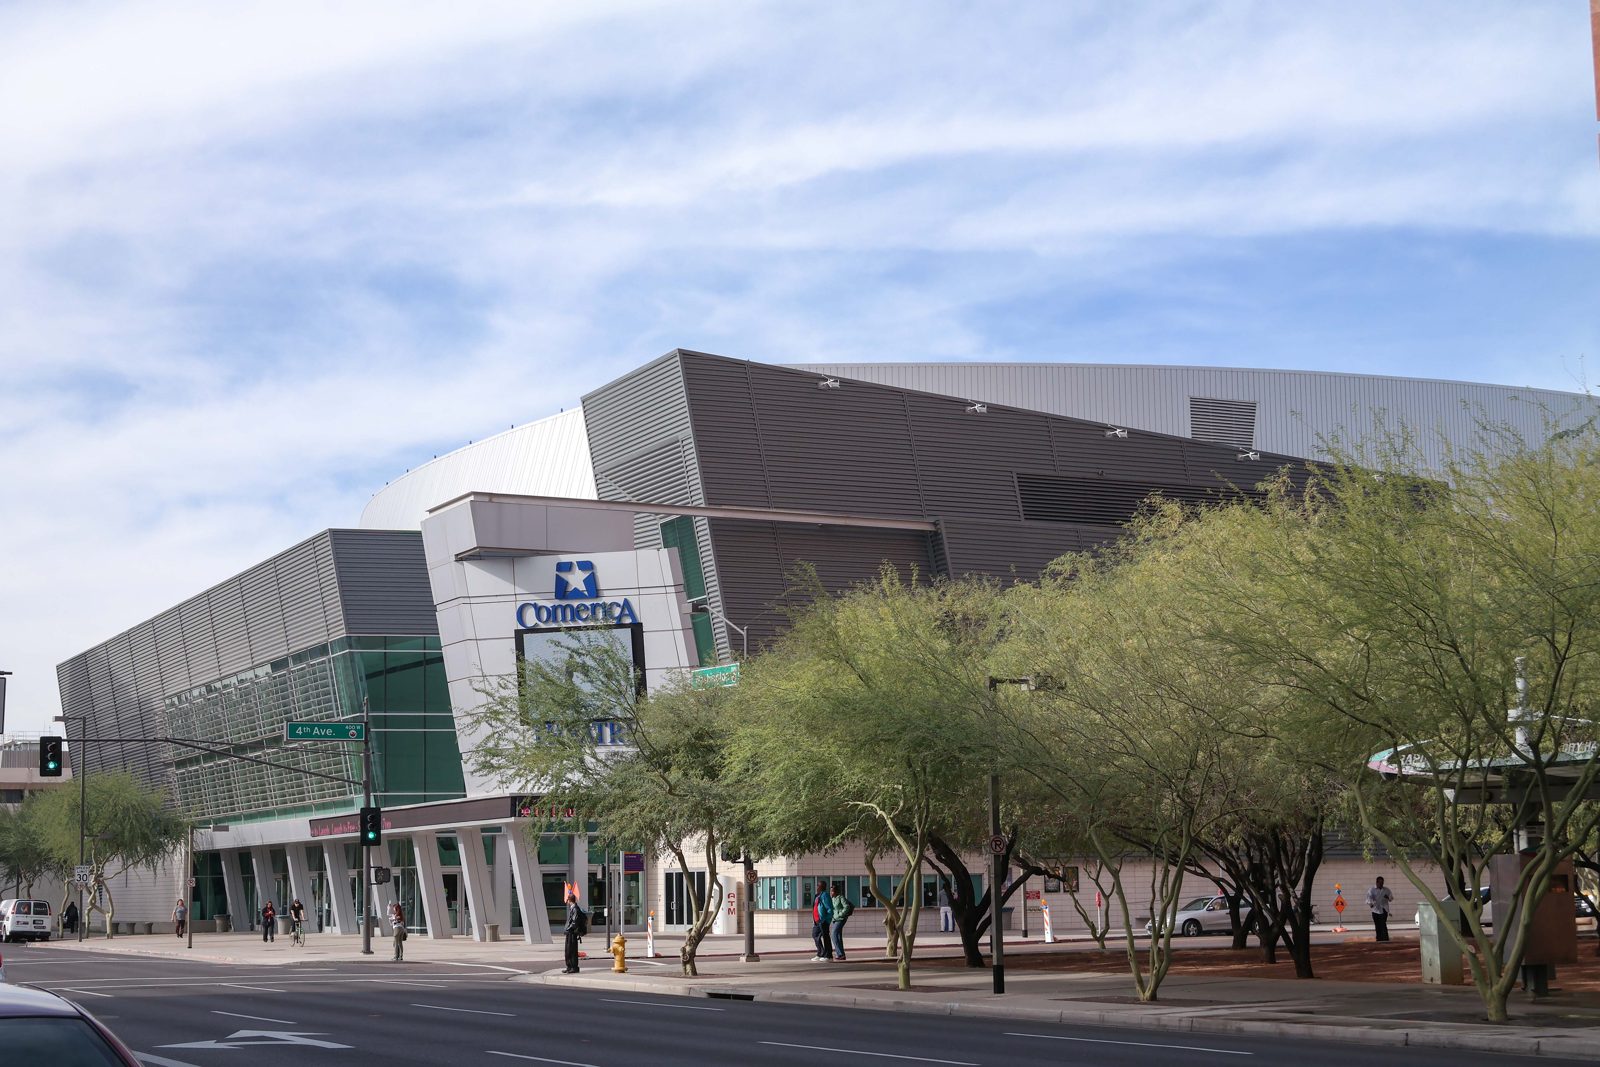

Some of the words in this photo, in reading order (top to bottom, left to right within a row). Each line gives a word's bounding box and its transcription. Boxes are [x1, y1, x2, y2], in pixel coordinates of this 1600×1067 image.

[296, 726, 311, 736] 4th
[313, 726, 336, 736] Ave.
[76, 873, 88, 882] 30
[727, 892, 736, 916] ATM
